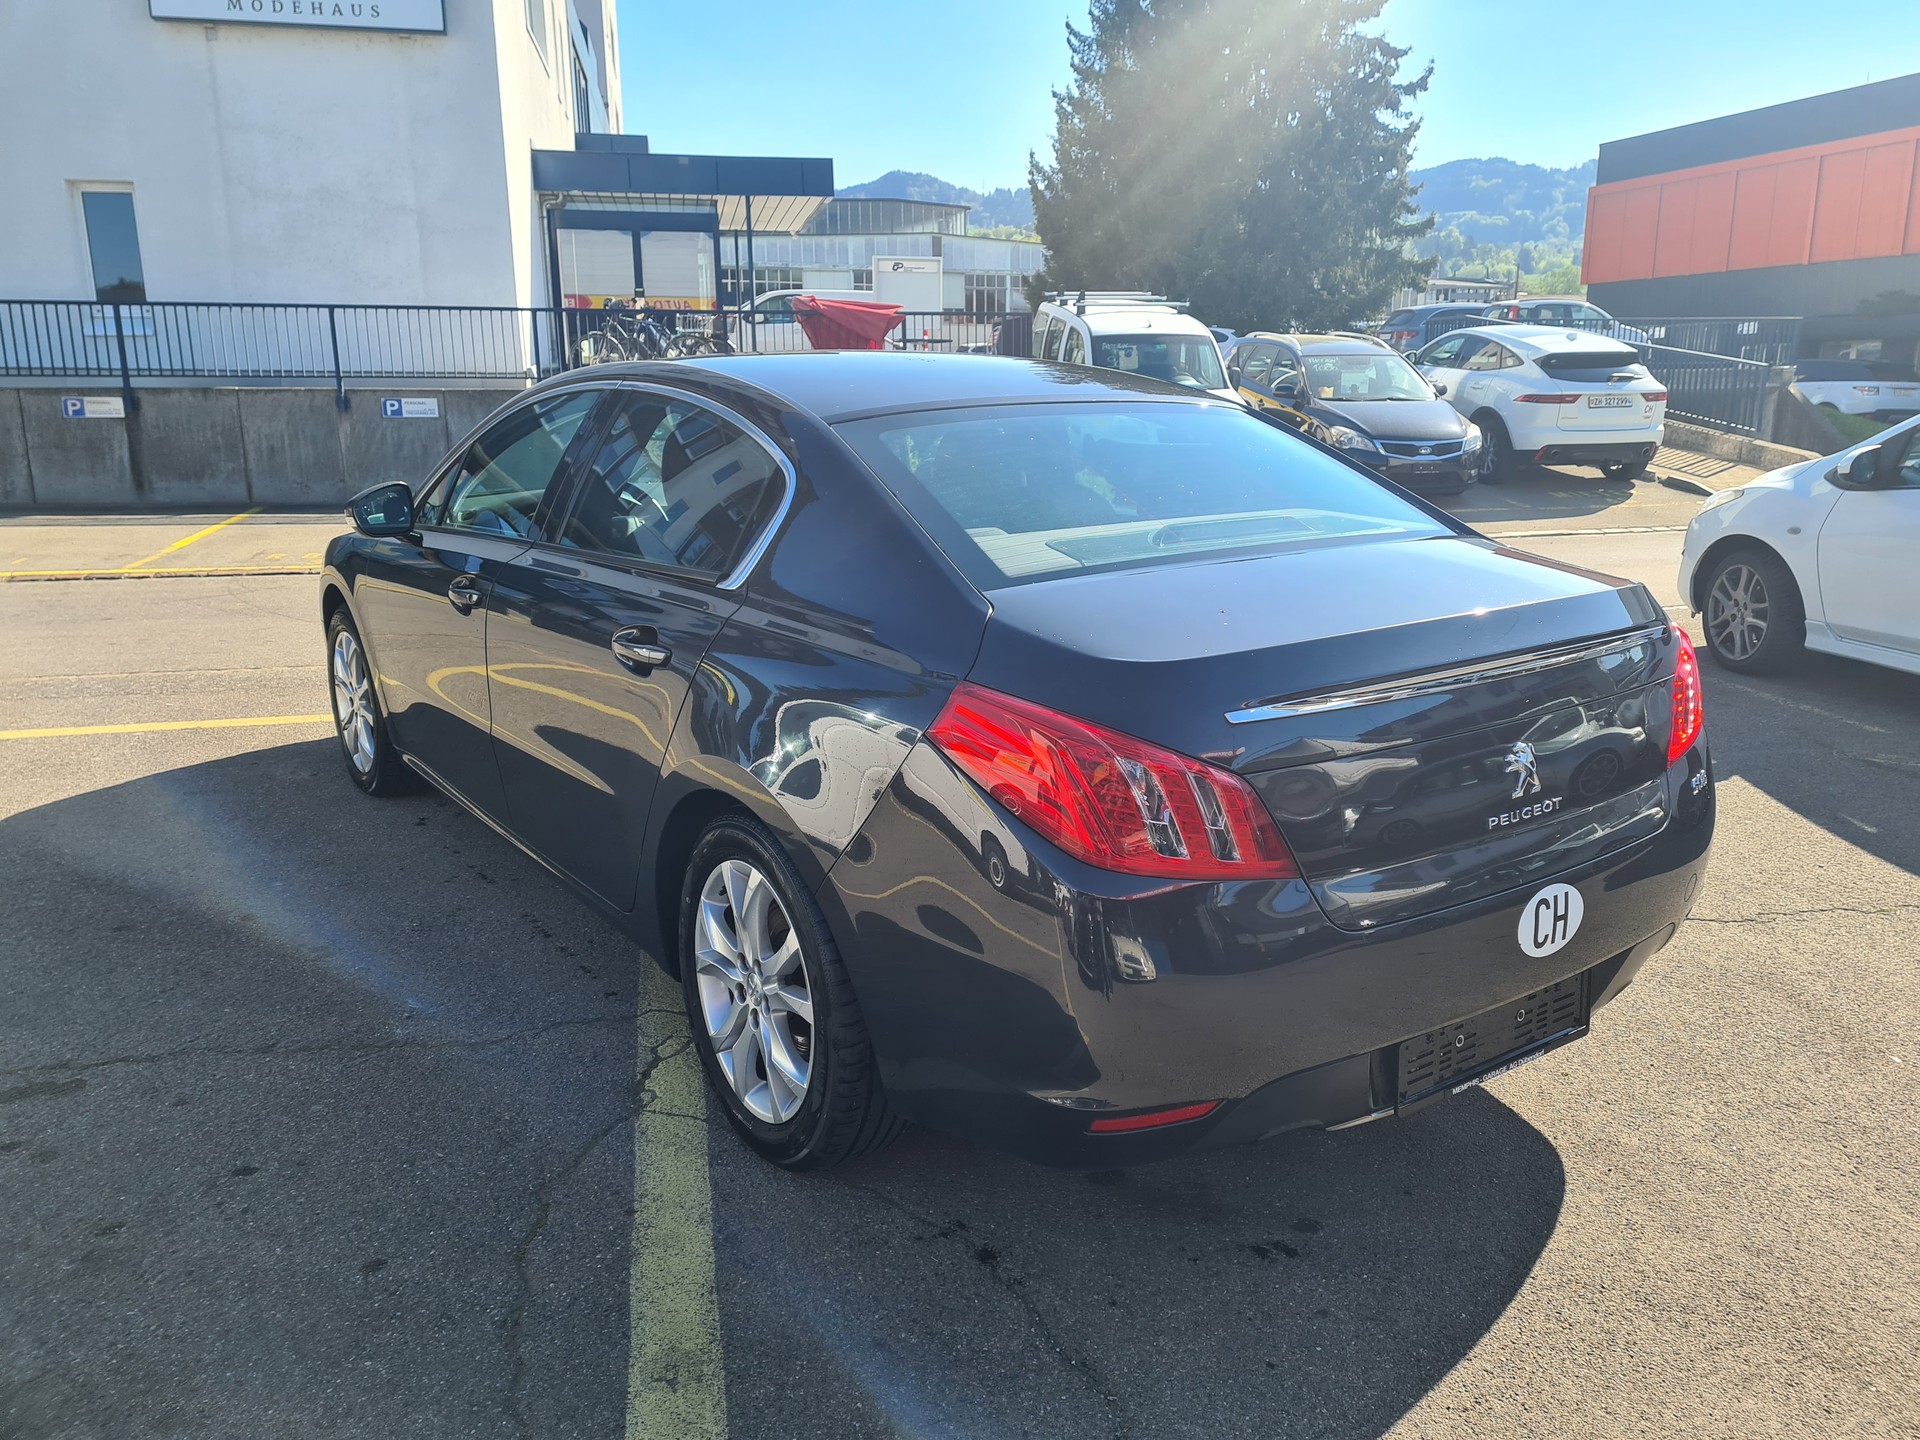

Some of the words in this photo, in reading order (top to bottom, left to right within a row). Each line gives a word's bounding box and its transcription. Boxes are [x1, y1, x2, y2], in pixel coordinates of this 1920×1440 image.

[227, 0, 381, 18] MODEHAUS
[1644, 404, 1653, 414] CH
[1488, 797, 1563, 830] PEUGEOT
[1533, 891, 1569, 949] CH
[1508, 1061, 1518, 1070] AG
